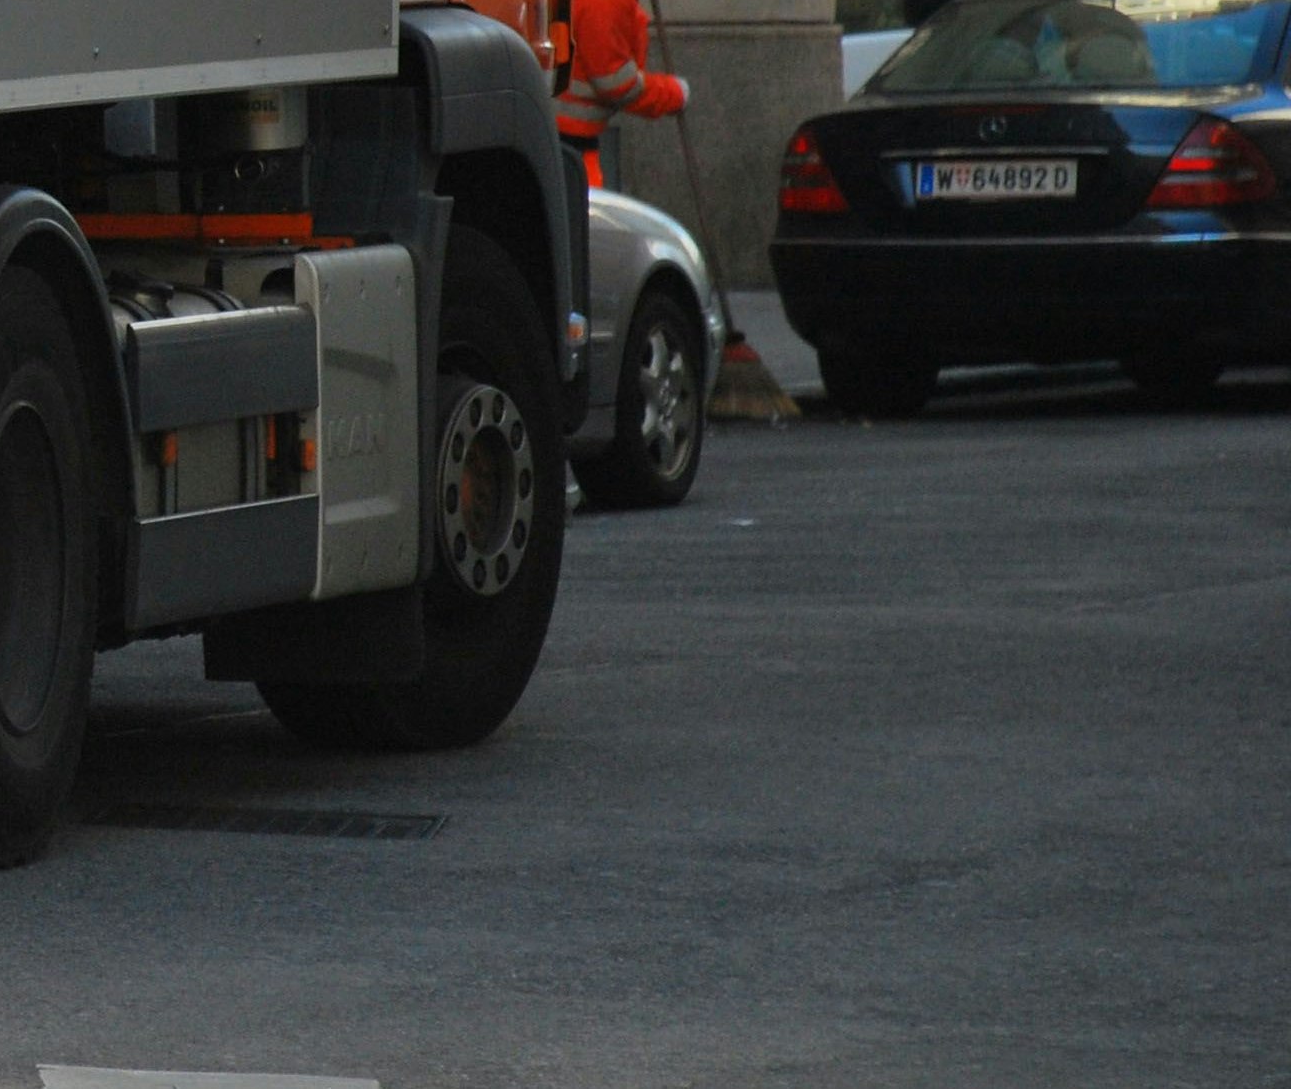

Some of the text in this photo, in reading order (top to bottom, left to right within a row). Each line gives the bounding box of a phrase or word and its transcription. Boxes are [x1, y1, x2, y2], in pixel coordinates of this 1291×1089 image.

[937, 164, 1068, 192] W 64892 D
